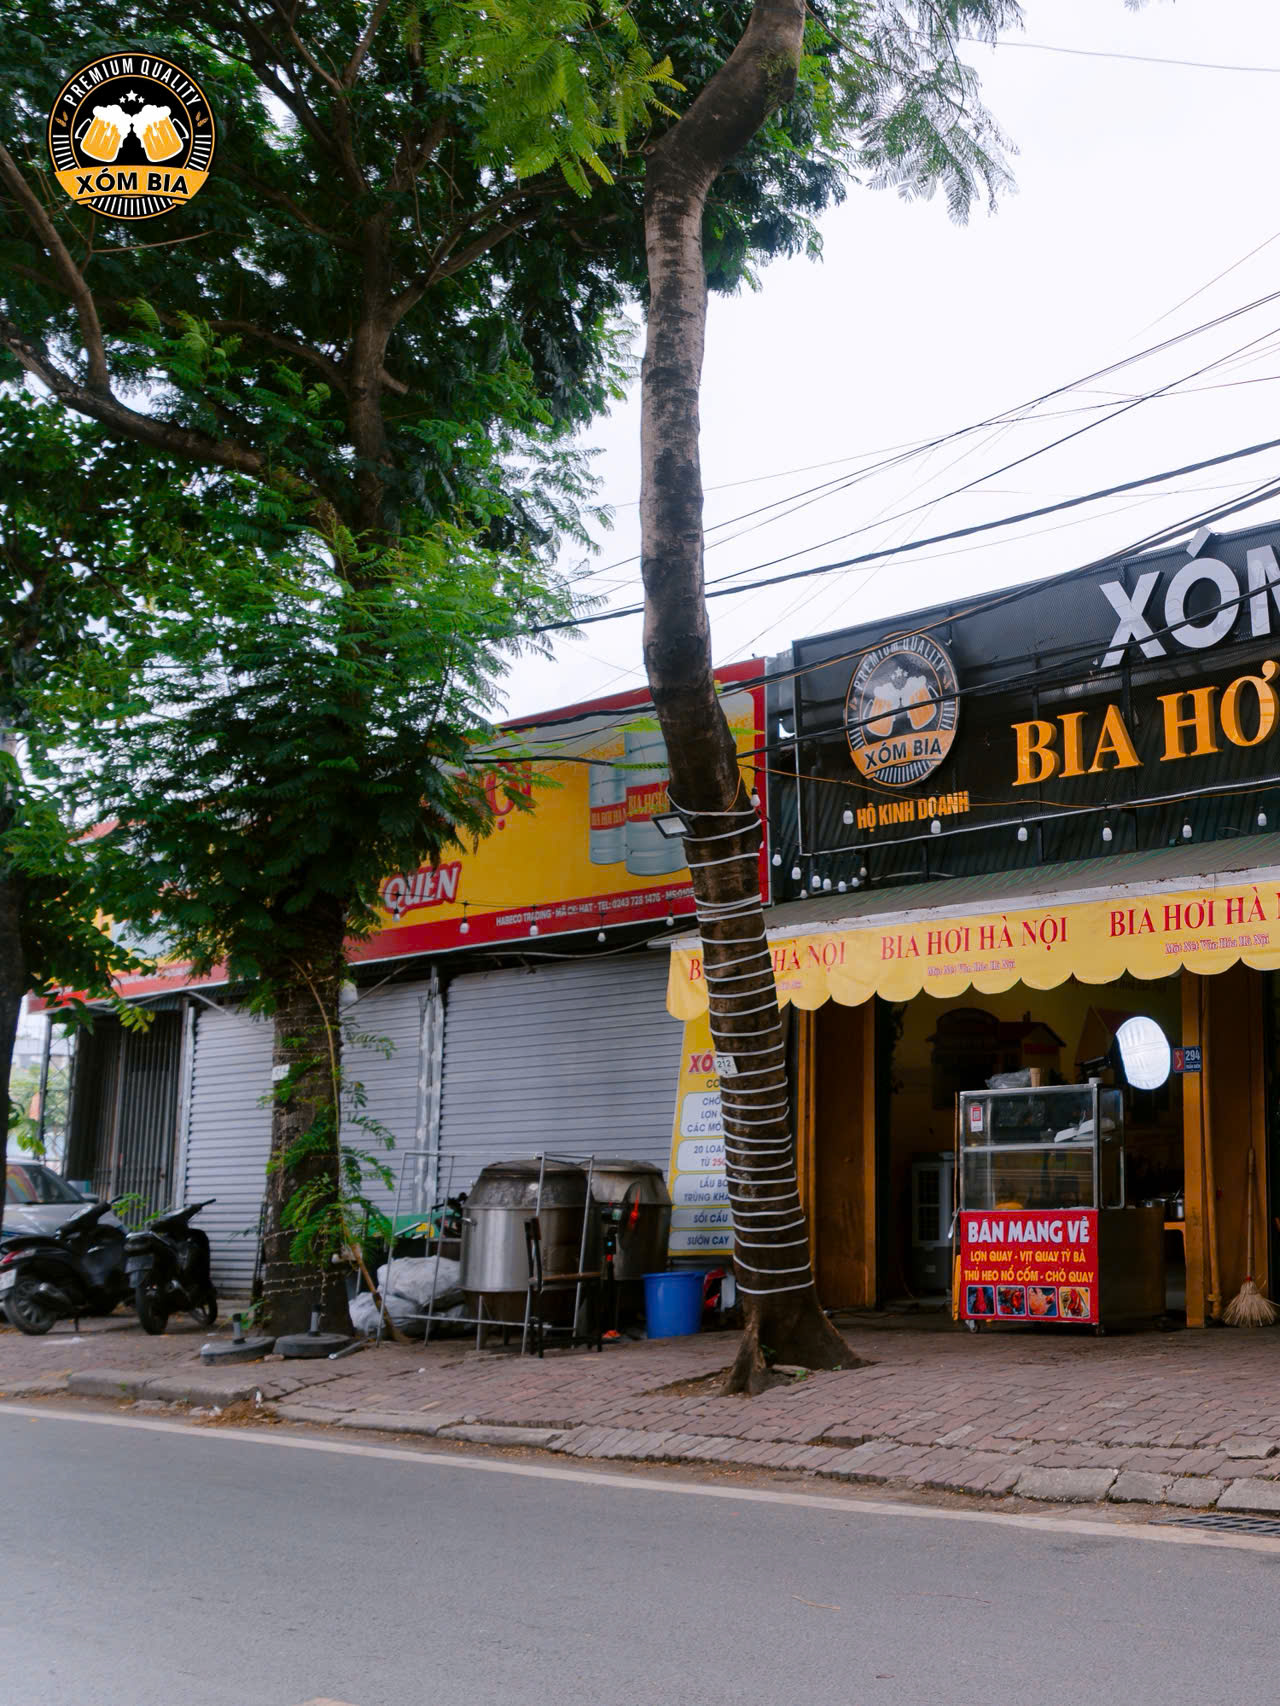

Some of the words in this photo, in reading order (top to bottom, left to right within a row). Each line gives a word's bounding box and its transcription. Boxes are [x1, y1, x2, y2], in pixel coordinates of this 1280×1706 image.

[853, 641, 902, 690] PREMIUM
[903, 636, 946, 672] QUALITY
[864, 742, 906, 770] XÓM
[914, 738, 942, 756] BIA
[1011, 705, 1144, 786] BIA
[857, 803, 876, 832] HỘ
[879, 800, 914, 825] KINH
[918, 791, 969, 820] DOANH
[1109, 908, 1156, 937] BIA
[1162, 898, 1215, 932] HƠI
[1224, 886, 1267, 925] HÀ
[881, 934, 920, 961] BIA
[927, 926, 970, 956] HƠI
[979, 915, 1013, 950] HÀ
[1021, 914, 1069, 952] NỘI
[772, 939, 800, 972] HÀ
[808, 939, 846, 973] NỘI
[688, 1050, 717, 1073] XÓ
[1185, 1049, 1200, 1060] 294
[711, 1236, 730, 1245] CAY
[968, 1218, 1004, 1243] BÁN
[1007, 1220, 1063, 1243] MANG
[1067, 1216, 1090, 1243] VỀ
[970, 1250, 987, 1265] LỢN
[989, 1250, 1013, 1262] QUAY
[1019, 1250, 1033, 1264] VỊT
[1035, 1250, 1060, 1262] QUAY
[981, 1270, 999, 1281] HEO
[1068, 1271, 1094, 1283] QUAY
